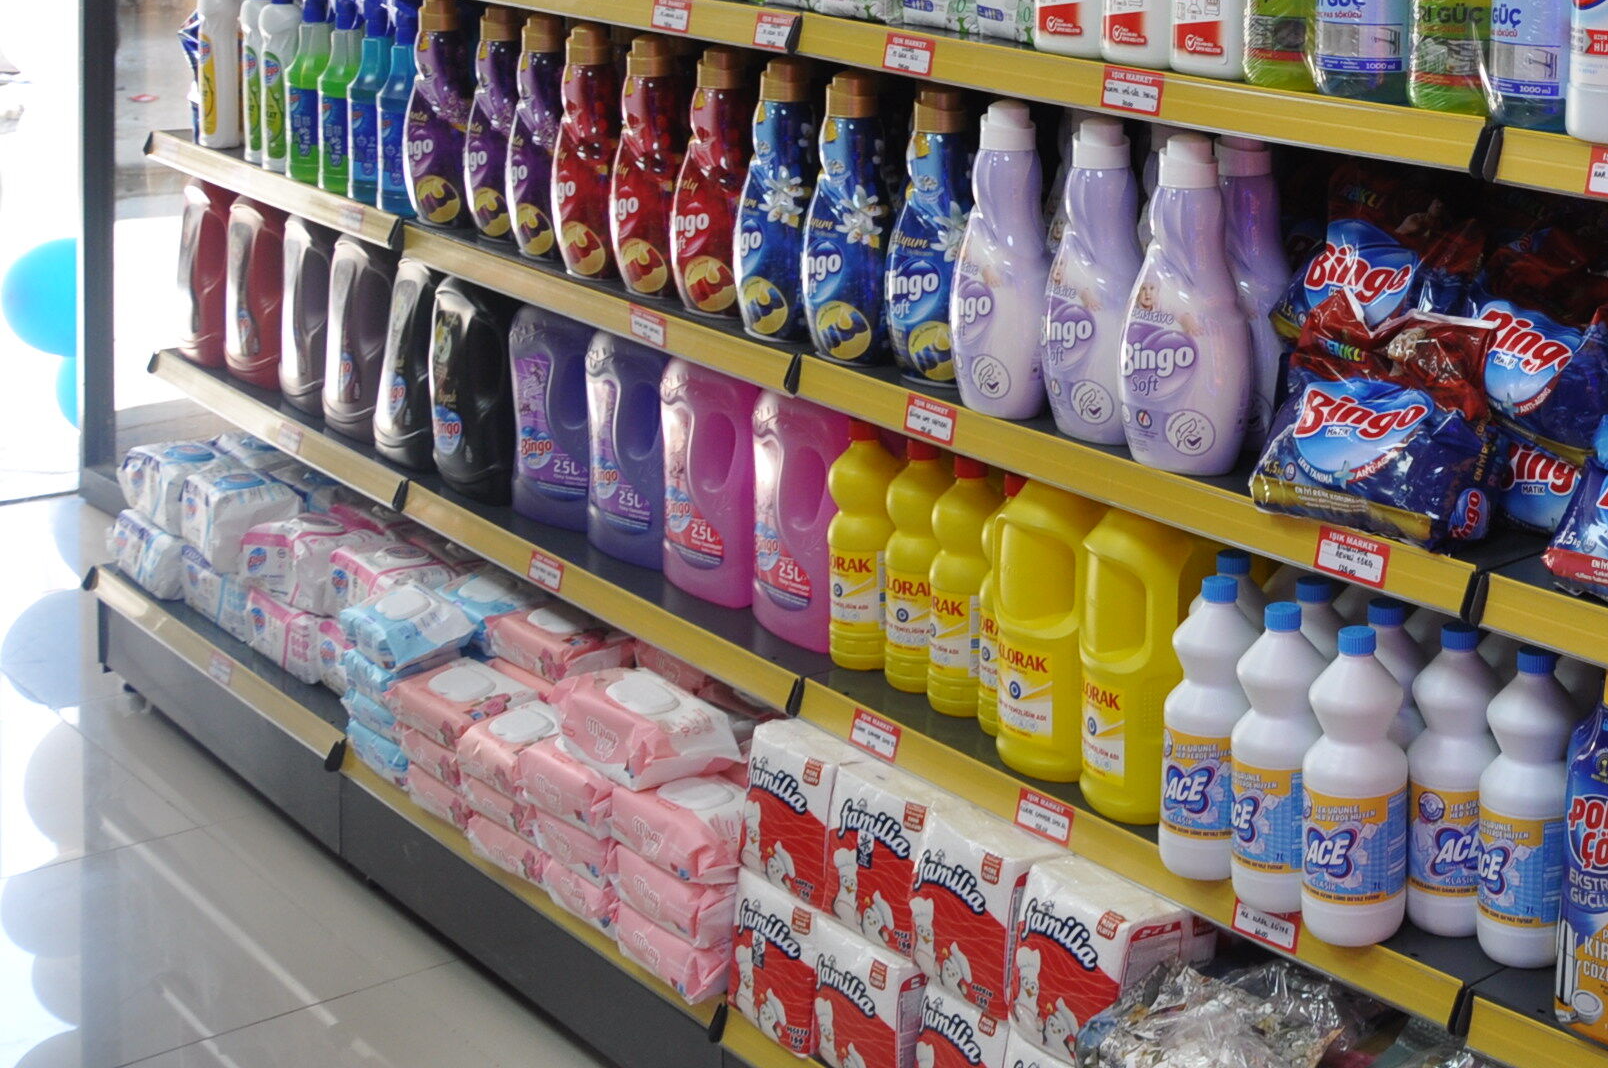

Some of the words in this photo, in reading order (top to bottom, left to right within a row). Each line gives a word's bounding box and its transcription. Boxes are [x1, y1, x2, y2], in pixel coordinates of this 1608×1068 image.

[1437, 3, 1484, 26] GÜÇ
[1492, 6, 1522, 28] GÜÇ
[1365, 61, 1387, 71] 1000
[1519, 84, 1541, 95] 1000
[1131, 376, 1159, 393] Soft
[1355, 456, 1400, 479] ANTI-AGING
[1166, 776, 1207, 803] ACE
[839, 799, 912, 859] familia
[1306, 840, 1351, 867] ACE
[913, 852, 985, 914] familia
[739, 899, 800, 959] familia
[1023, 900, 1098, 970] familia
[816, 953, 876, 1019] familia
